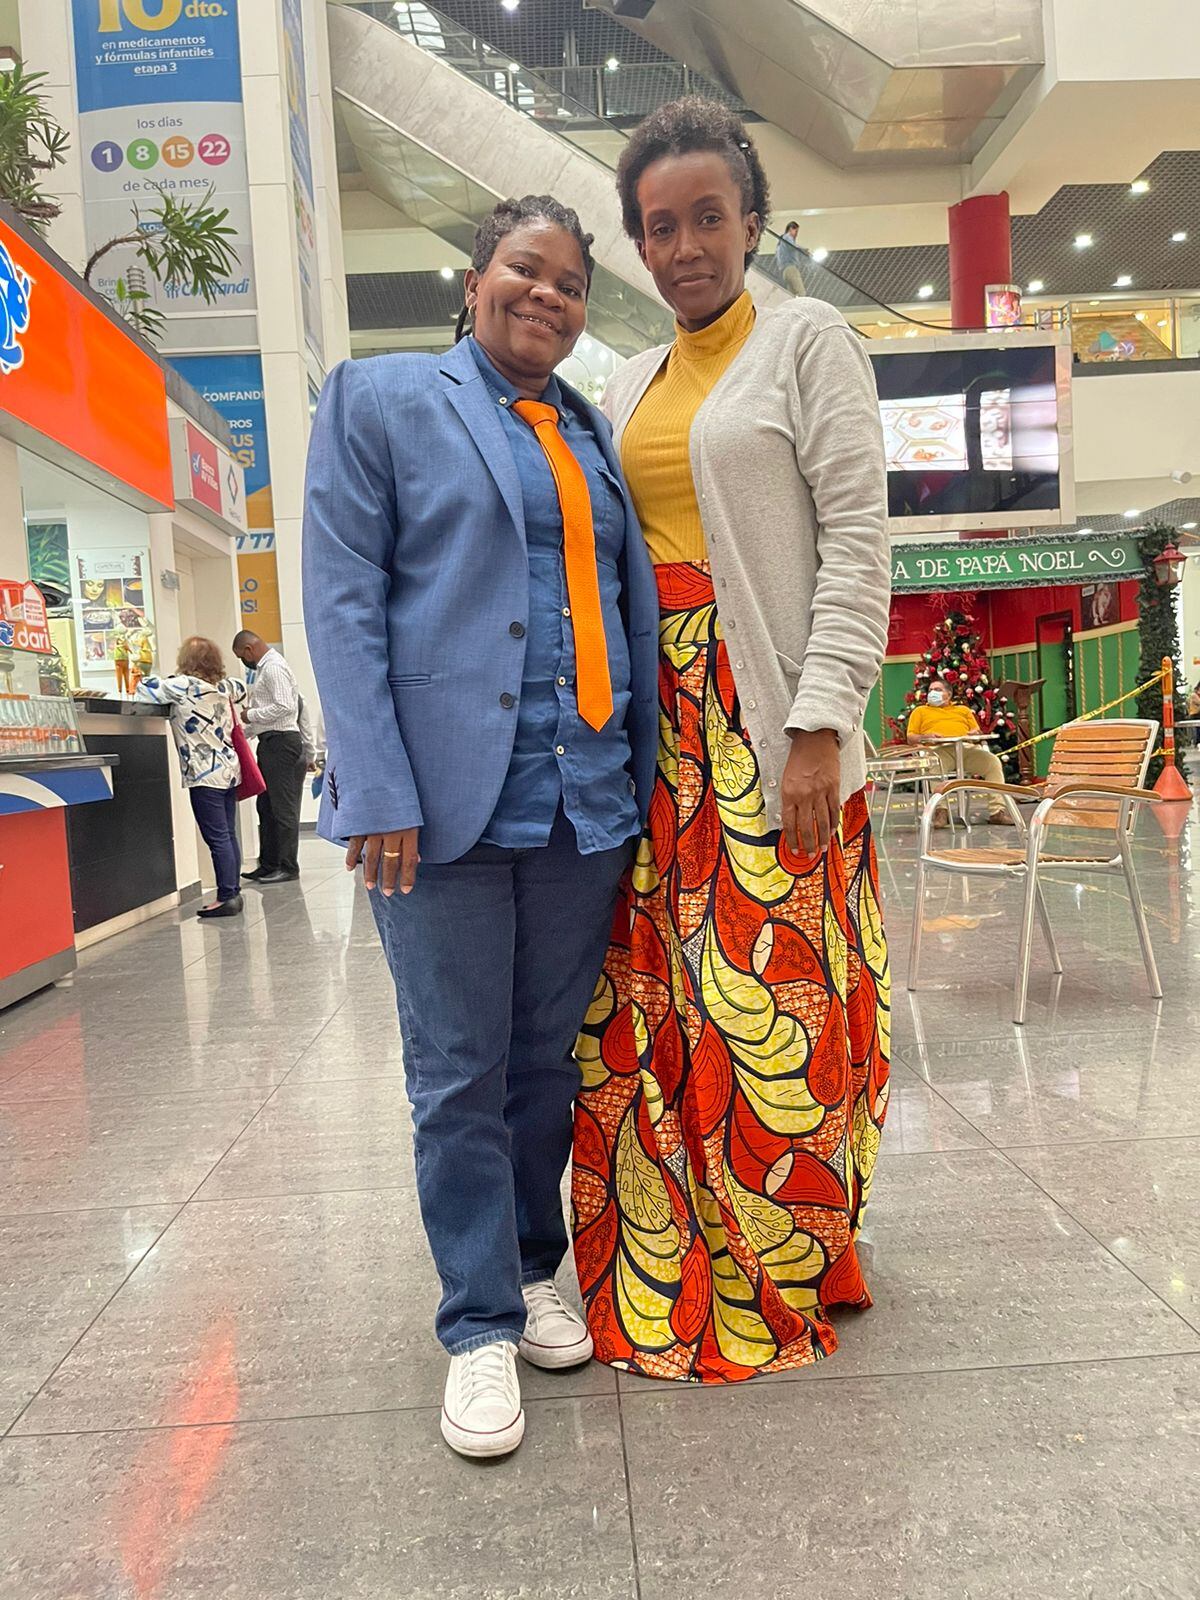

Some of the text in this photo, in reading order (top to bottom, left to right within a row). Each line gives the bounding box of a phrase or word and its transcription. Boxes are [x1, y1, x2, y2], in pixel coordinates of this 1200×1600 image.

[102, 36, 206, 50] en medicamentos
[95, 47, 214, 64] y fórmulas infantiles
[134, 62, 177, 74] etapa 3
[137, 116, 183, 129] los días
[102, 141, 228, 164] 1 8 15 22
[123, 178, 209, 192] de cada mes
[916, 559, 951, 578] DE
[955, 551, 1013, 576] PAPÁ
[1018, 550, 1084, 572] NOEL
